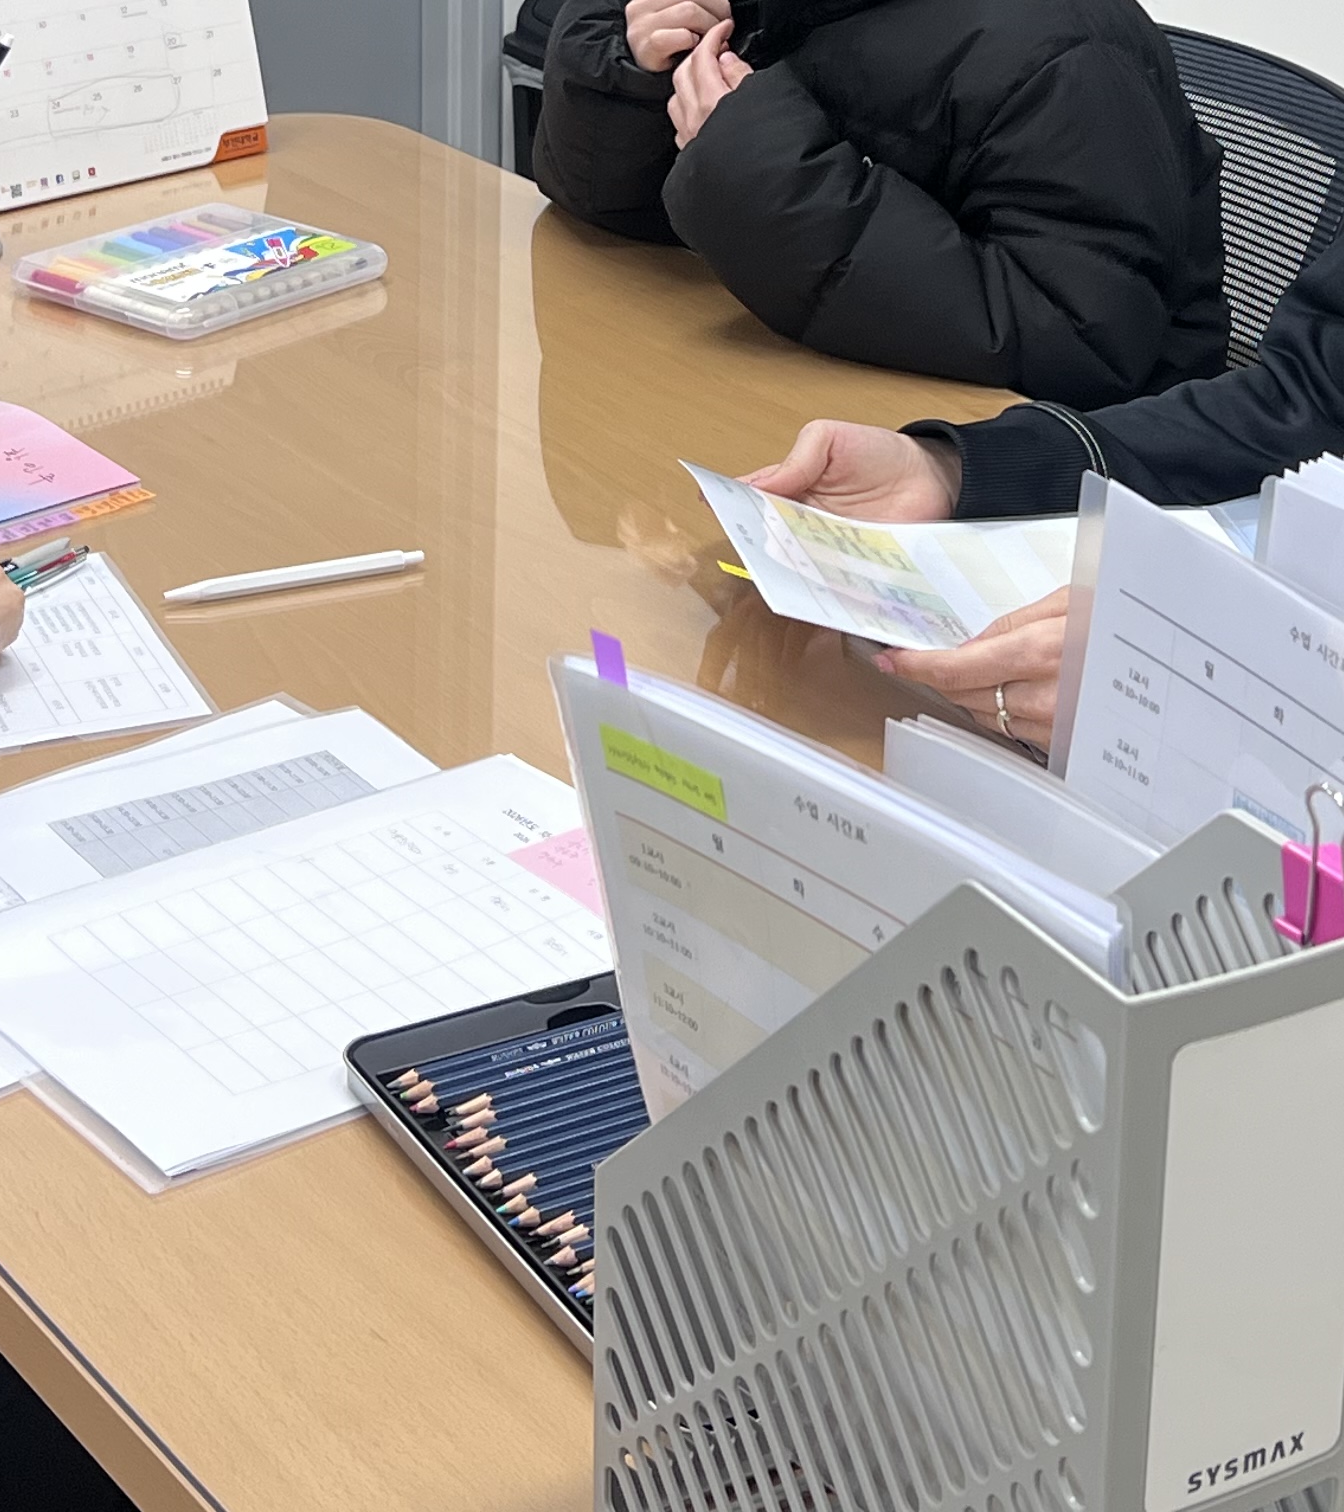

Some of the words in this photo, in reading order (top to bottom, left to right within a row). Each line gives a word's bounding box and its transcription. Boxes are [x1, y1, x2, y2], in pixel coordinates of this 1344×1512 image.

[120, 6, 128, 14] 12
[160, 0, 168, 7] 13
[167, 37, 177, 46] 20
[10, 109, 20, 118] 23
[51, 100, 61, 109] 24
[93, 92, 103, 101] 25
[134, 84, 143, 92] 26
[173, 76, 182, 85] 27
[1289, 626, 1312, 651] 수업
[1128, 667, 1150, 691] 1교시
[1204, 660, 1215, 680] 월
[1273, 705, 1285, 726] 화
[1117, 738, 1139, 762] 2교시
[794, 795, 819, 823] 수업
[826, 812, 868, 845] 시간표
[641, 843, 666, 865] 1교시
[712, 833, 725, 854] 월
[793, 878, 806, 899] 화
[872, 924, 885, 943] 수
[652, 912, 677, 934] 2교시
[565, 1047, 597, 1062] WATER
[1187, 1431, 1306, 1494] SYSMAX
